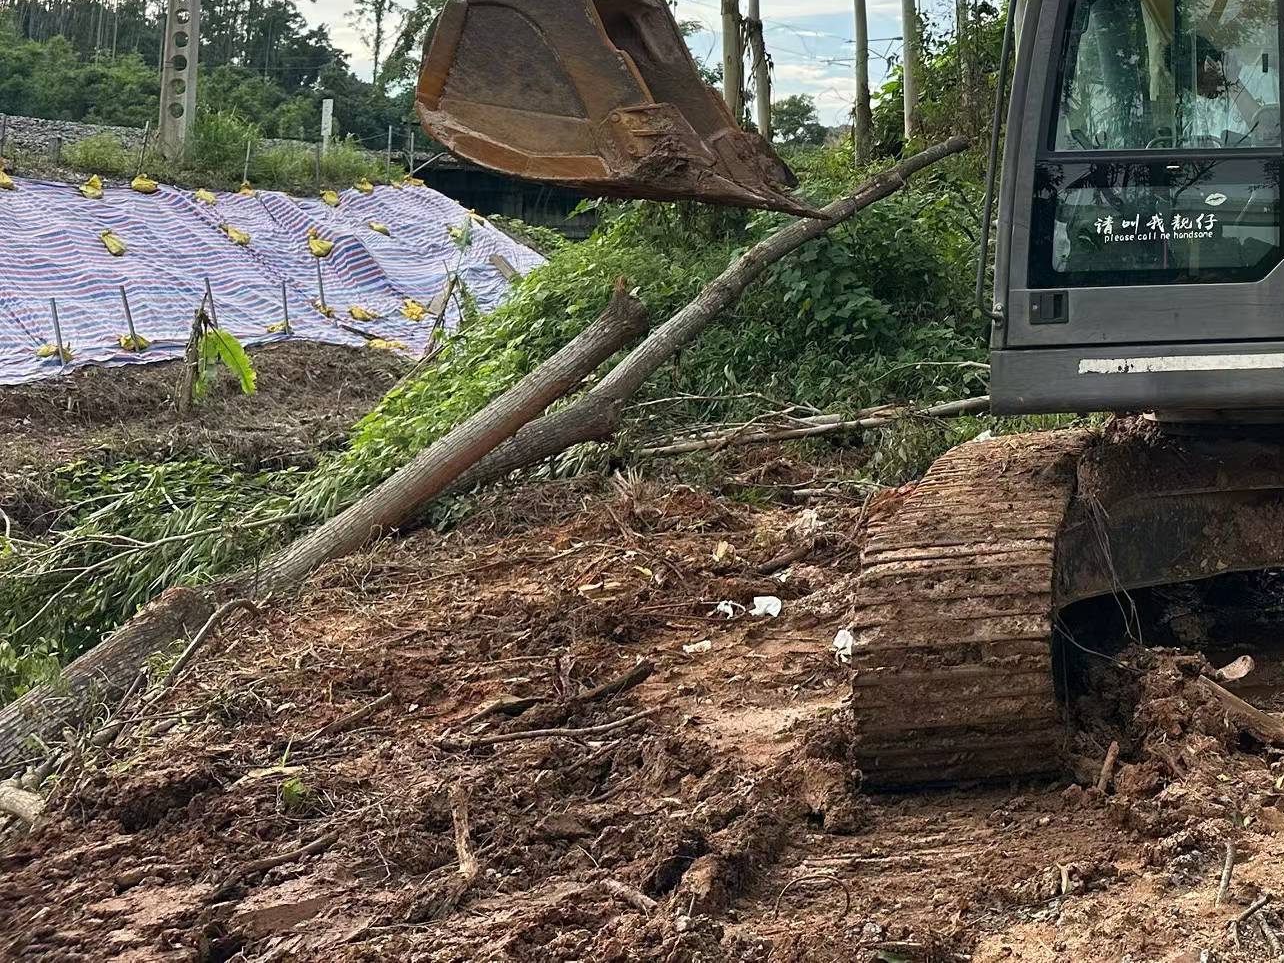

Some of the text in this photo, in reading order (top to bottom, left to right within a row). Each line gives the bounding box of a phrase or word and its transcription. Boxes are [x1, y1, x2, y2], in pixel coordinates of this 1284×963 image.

[1094, 212, 1218, 235] 请叫我靓仔
[1104, 232, 1135, 244] please
[1137, 231, 1157, 241] call
